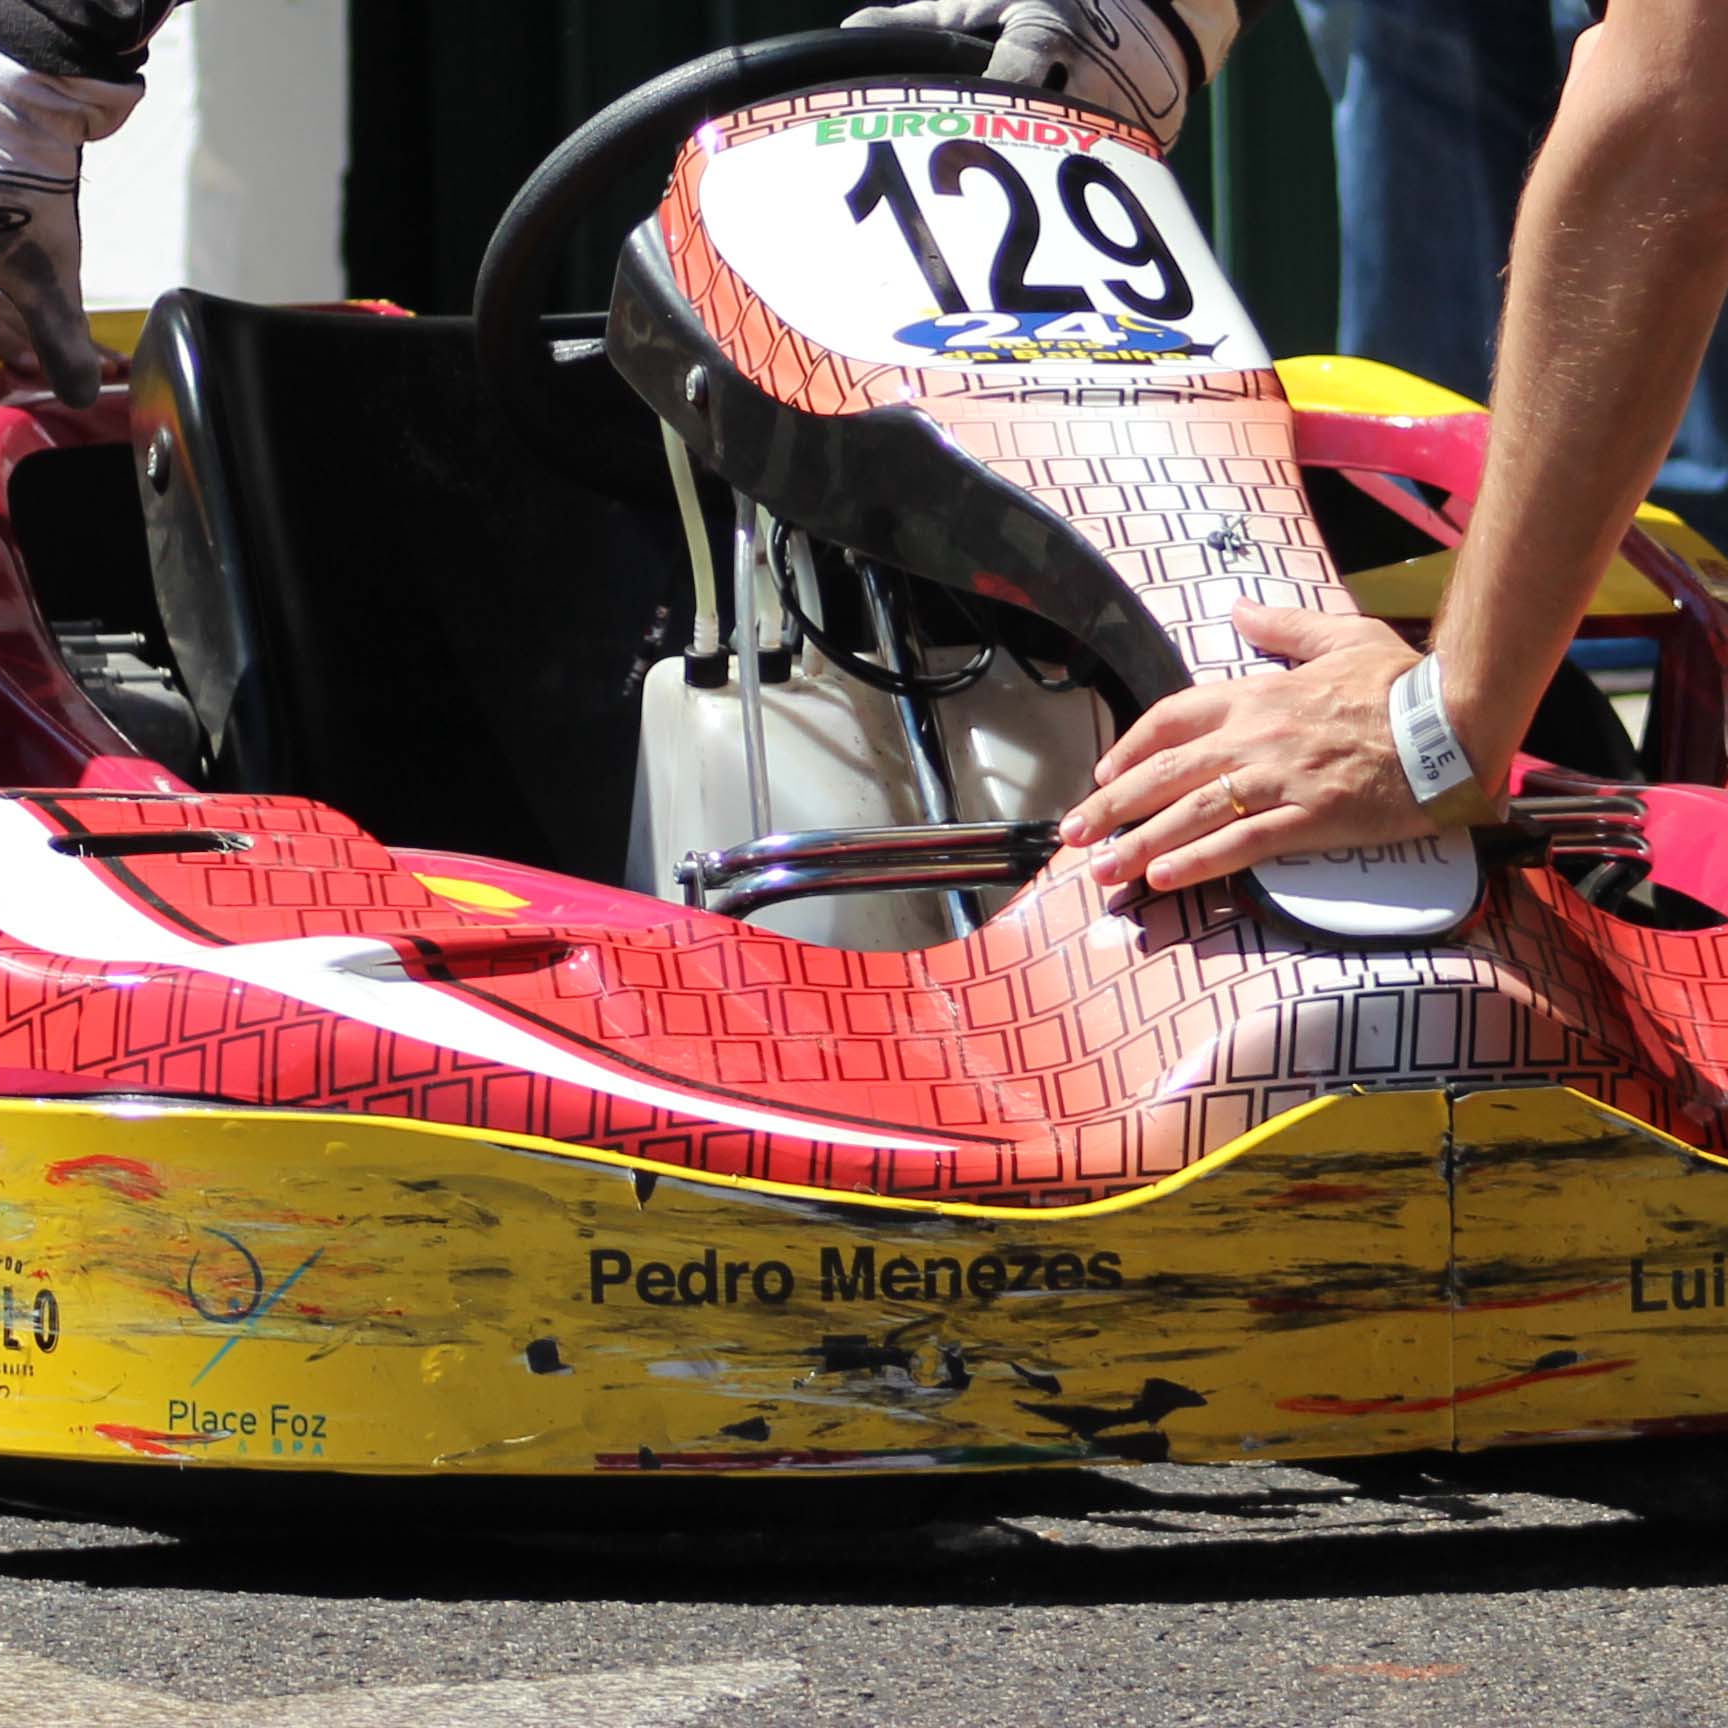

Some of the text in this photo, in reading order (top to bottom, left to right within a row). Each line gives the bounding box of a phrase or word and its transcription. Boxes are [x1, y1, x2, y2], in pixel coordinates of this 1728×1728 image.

[815, 111, 1104, 153] EUROINDY
[844, 138, 1193, 321] 129
[934, 311, 1129, 347] 24
[989, 338, 1105, 351] horas
[1418, 752, 1441, 783] 479
[589, 1243, 1124, 1306] Pedro Menezes
[168, 1399, 327, 1439] Place Foz
